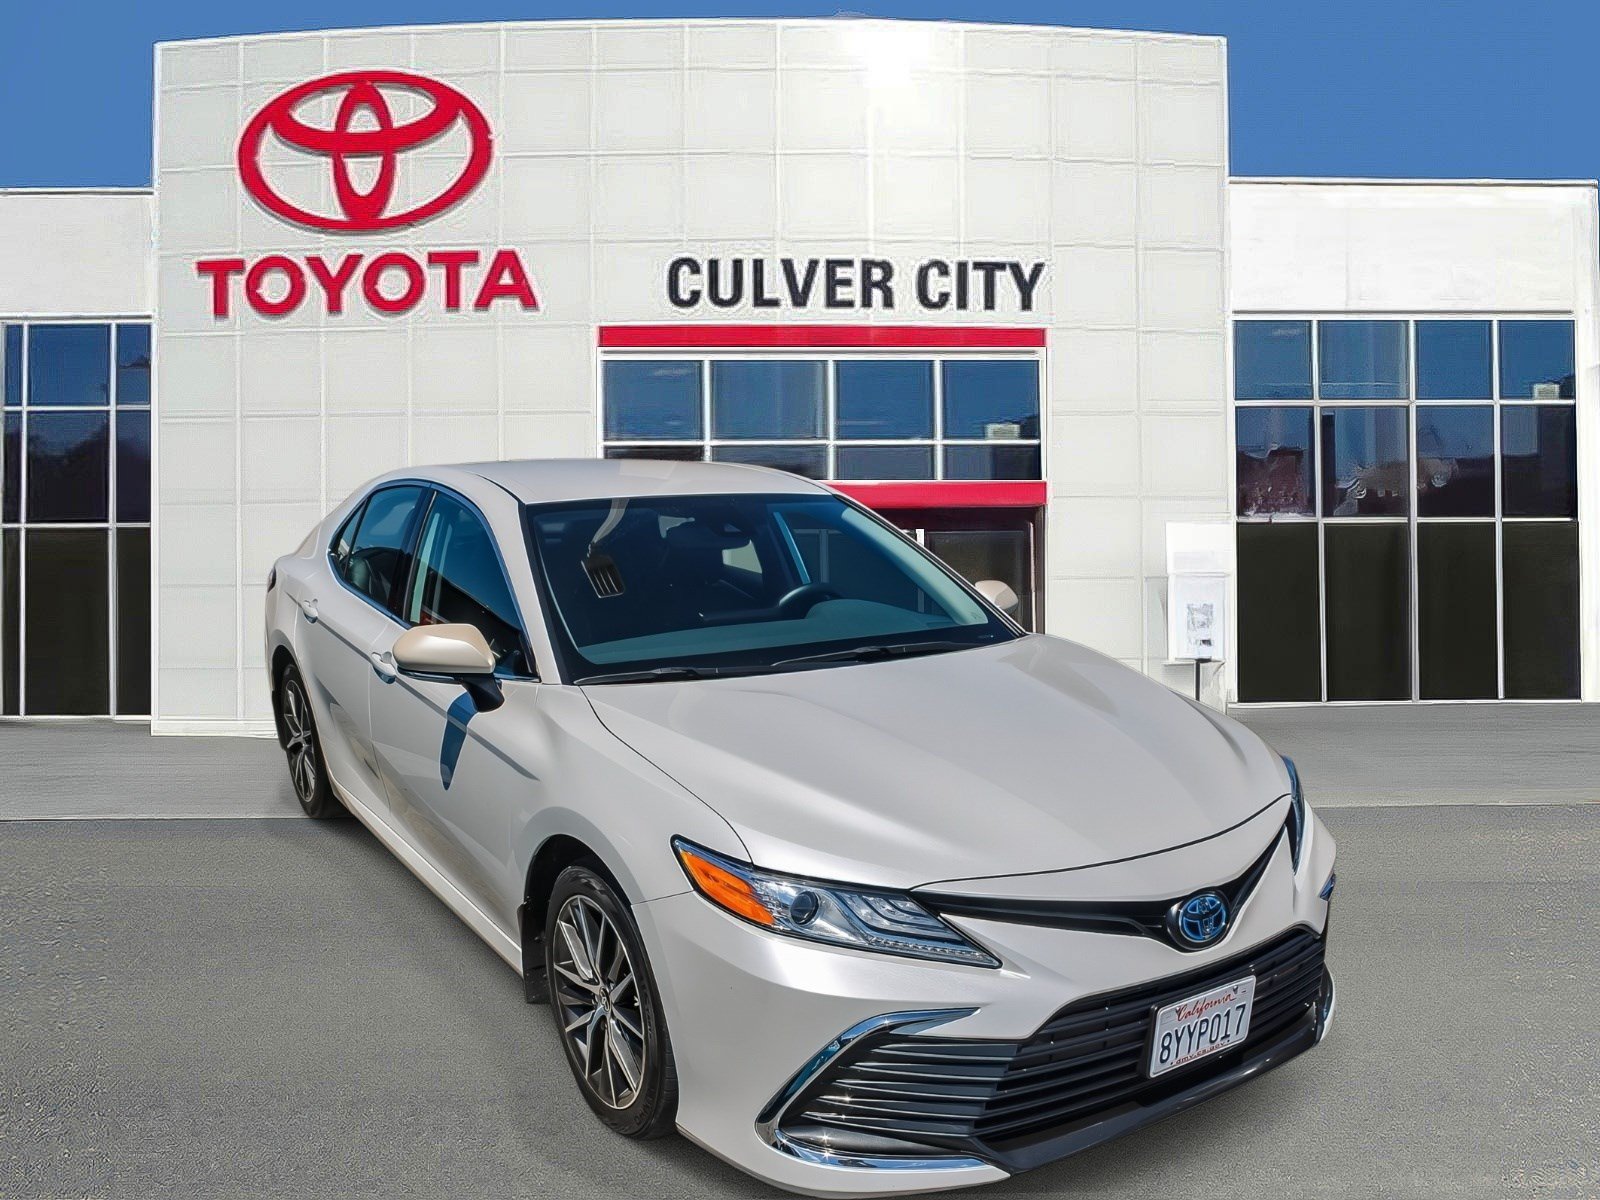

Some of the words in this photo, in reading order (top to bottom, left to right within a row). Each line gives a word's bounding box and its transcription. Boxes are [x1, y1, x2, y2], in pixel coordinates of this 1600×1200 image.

[195, 249, 540, 319] TOYOTA
[667, 257, 895, 310] CULVER
[915, 259, 1046, 312] CITY
[1159, 1003, 1247, 1064] 8YYP017
[1177, 992, 1237, 1022] California
